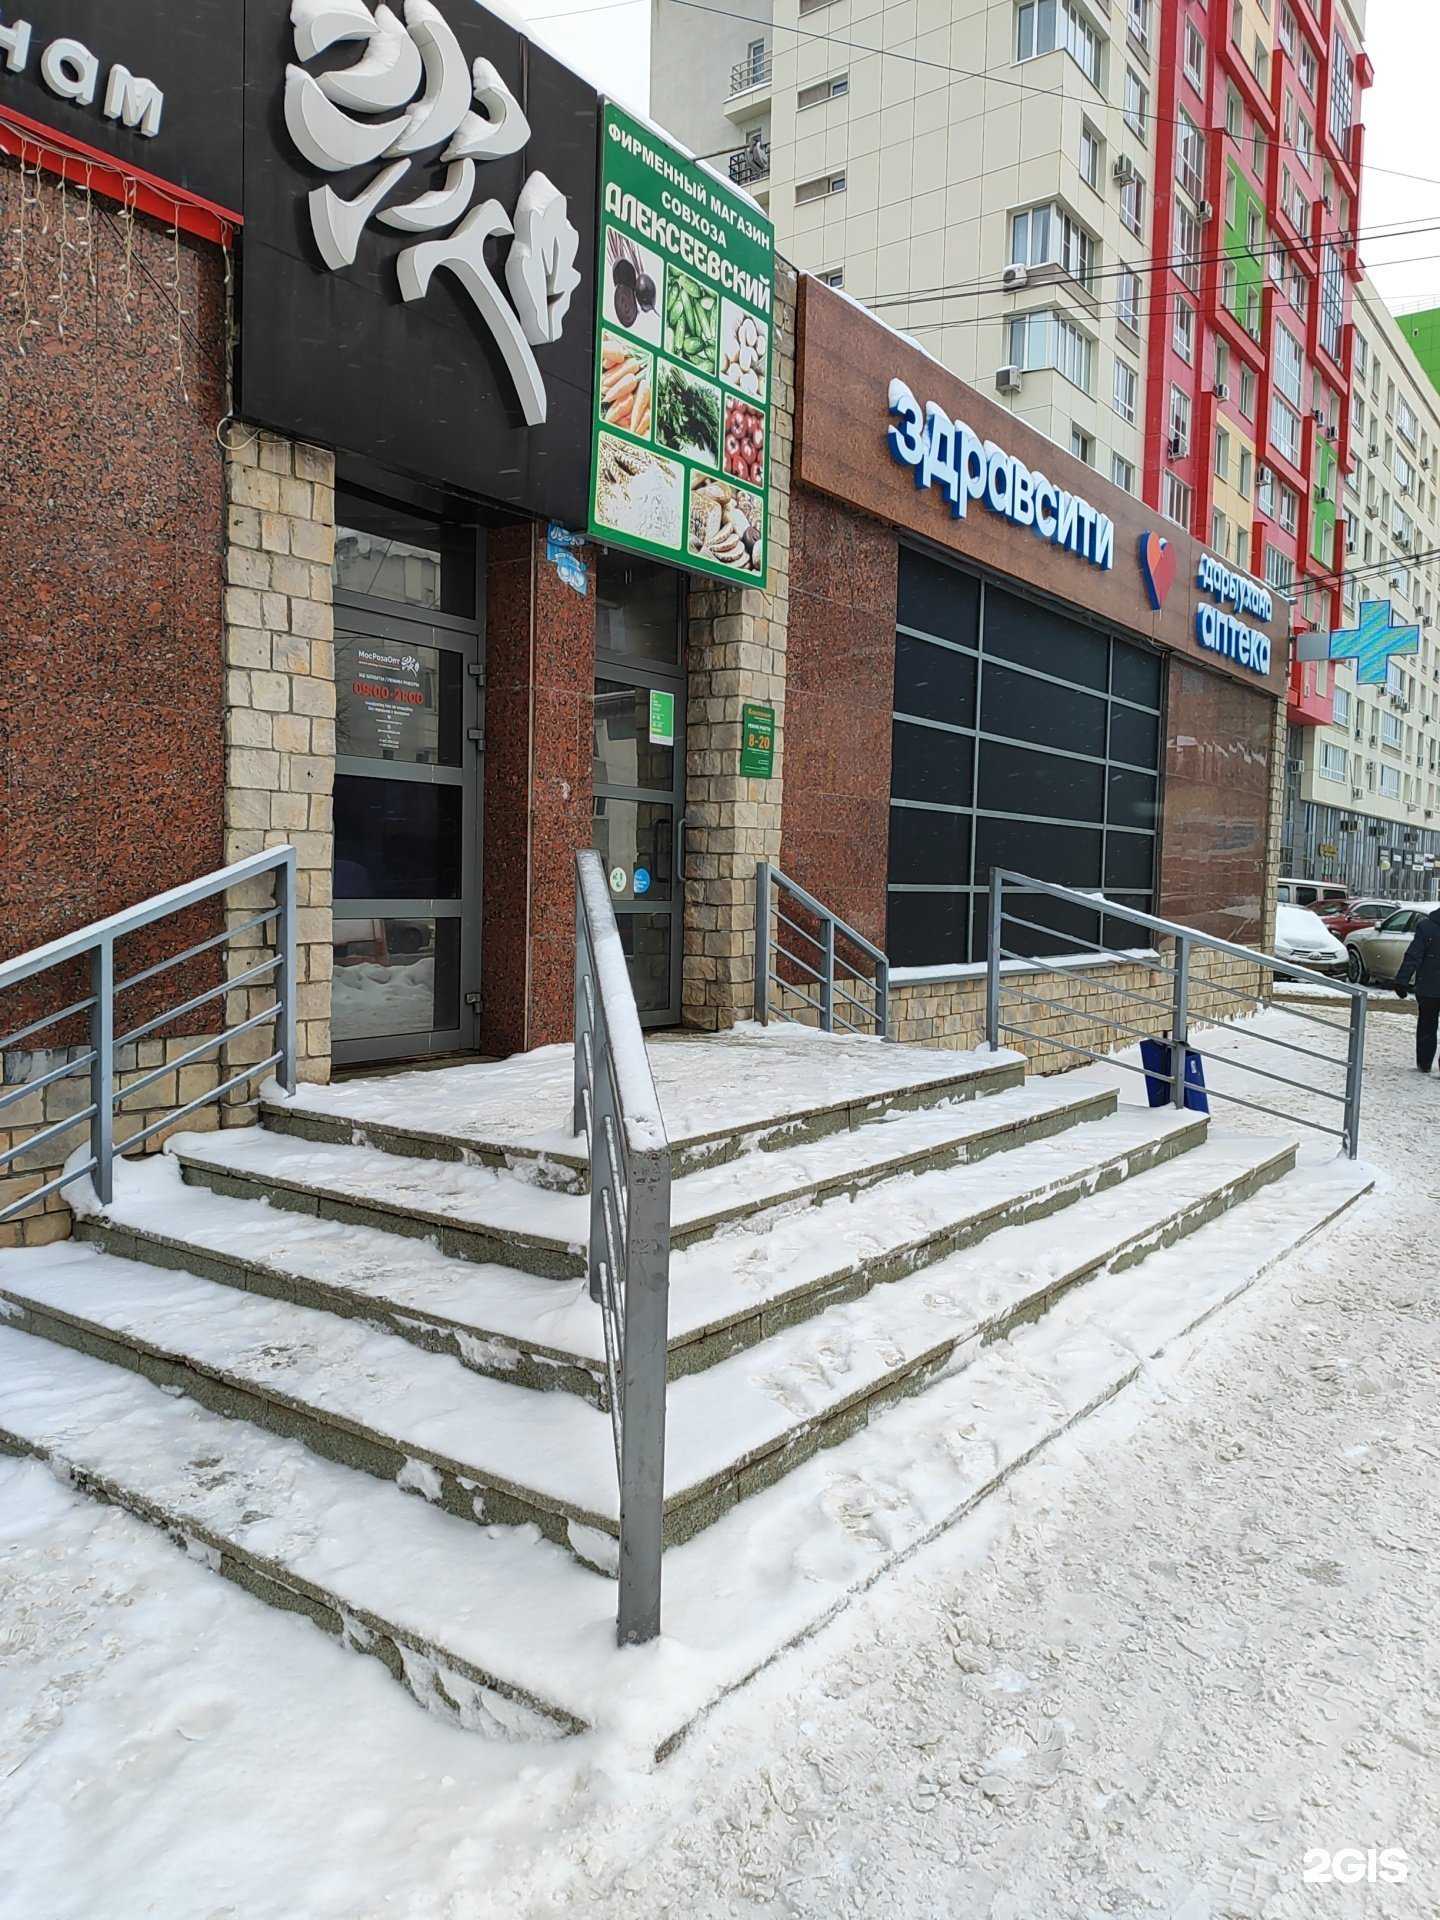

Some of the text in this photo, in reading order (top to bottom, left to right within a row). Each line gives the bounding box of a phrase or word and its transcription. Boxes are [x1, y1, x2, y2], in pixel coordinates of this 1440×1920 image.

[608, 123, 770, 250] ФИРМЕННЫЙ МАГАЗИН
[661, 190, 727, 249] СОВХОЗА
[605, 182, 771, 314] АЛЕКСЕЕВСКИЙ
[1197, 605, 1272, 676] аптека
